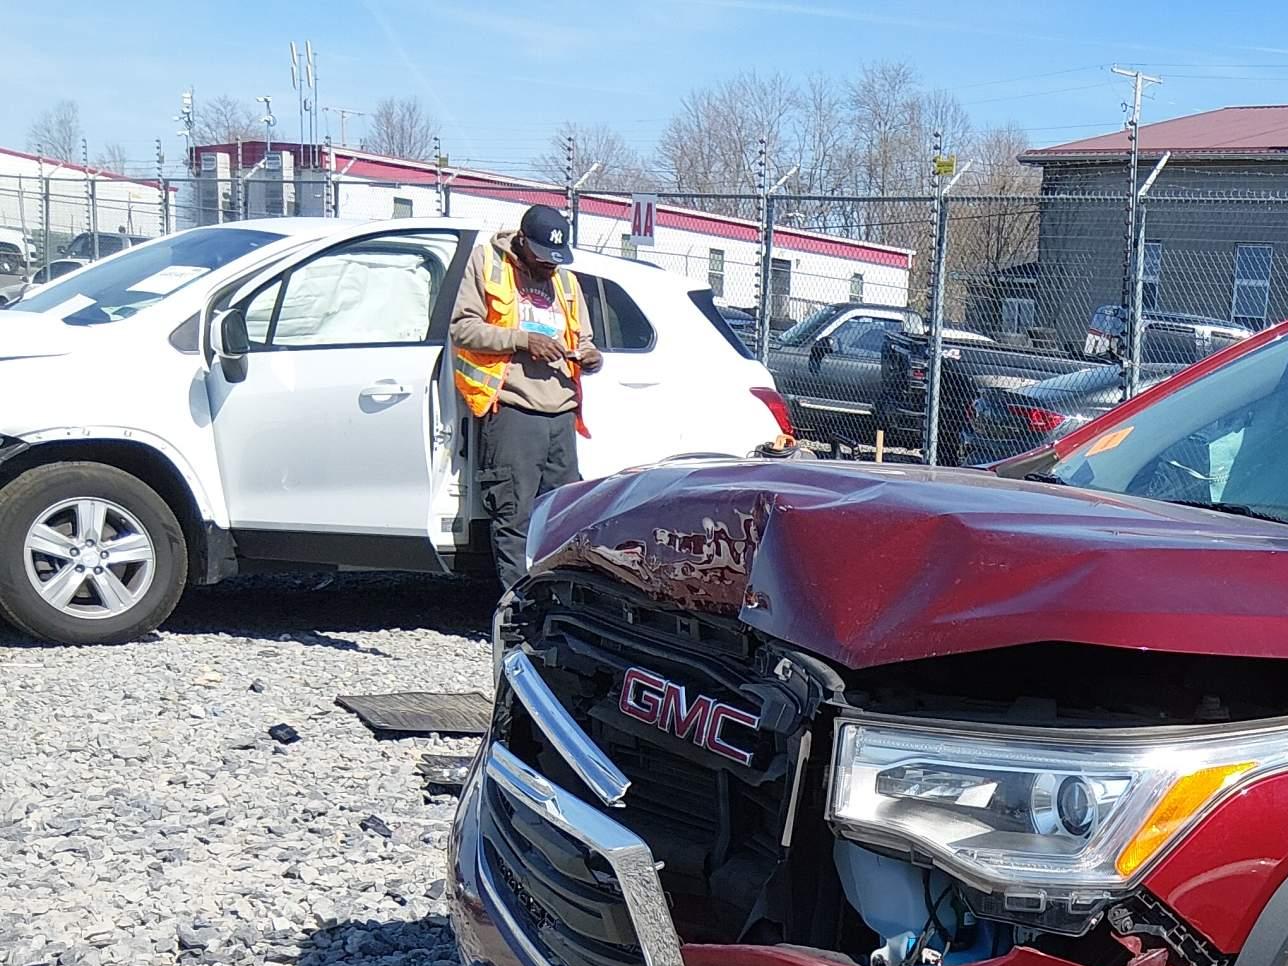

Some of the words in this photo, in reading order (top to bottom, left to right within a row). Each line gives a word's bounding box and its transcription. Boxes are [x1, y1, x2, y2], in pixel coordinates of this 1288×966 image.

[549, 229, 563, 244] NY
[632, 202, 653, 237] AA
[619, 667, 760, 768] GMC
